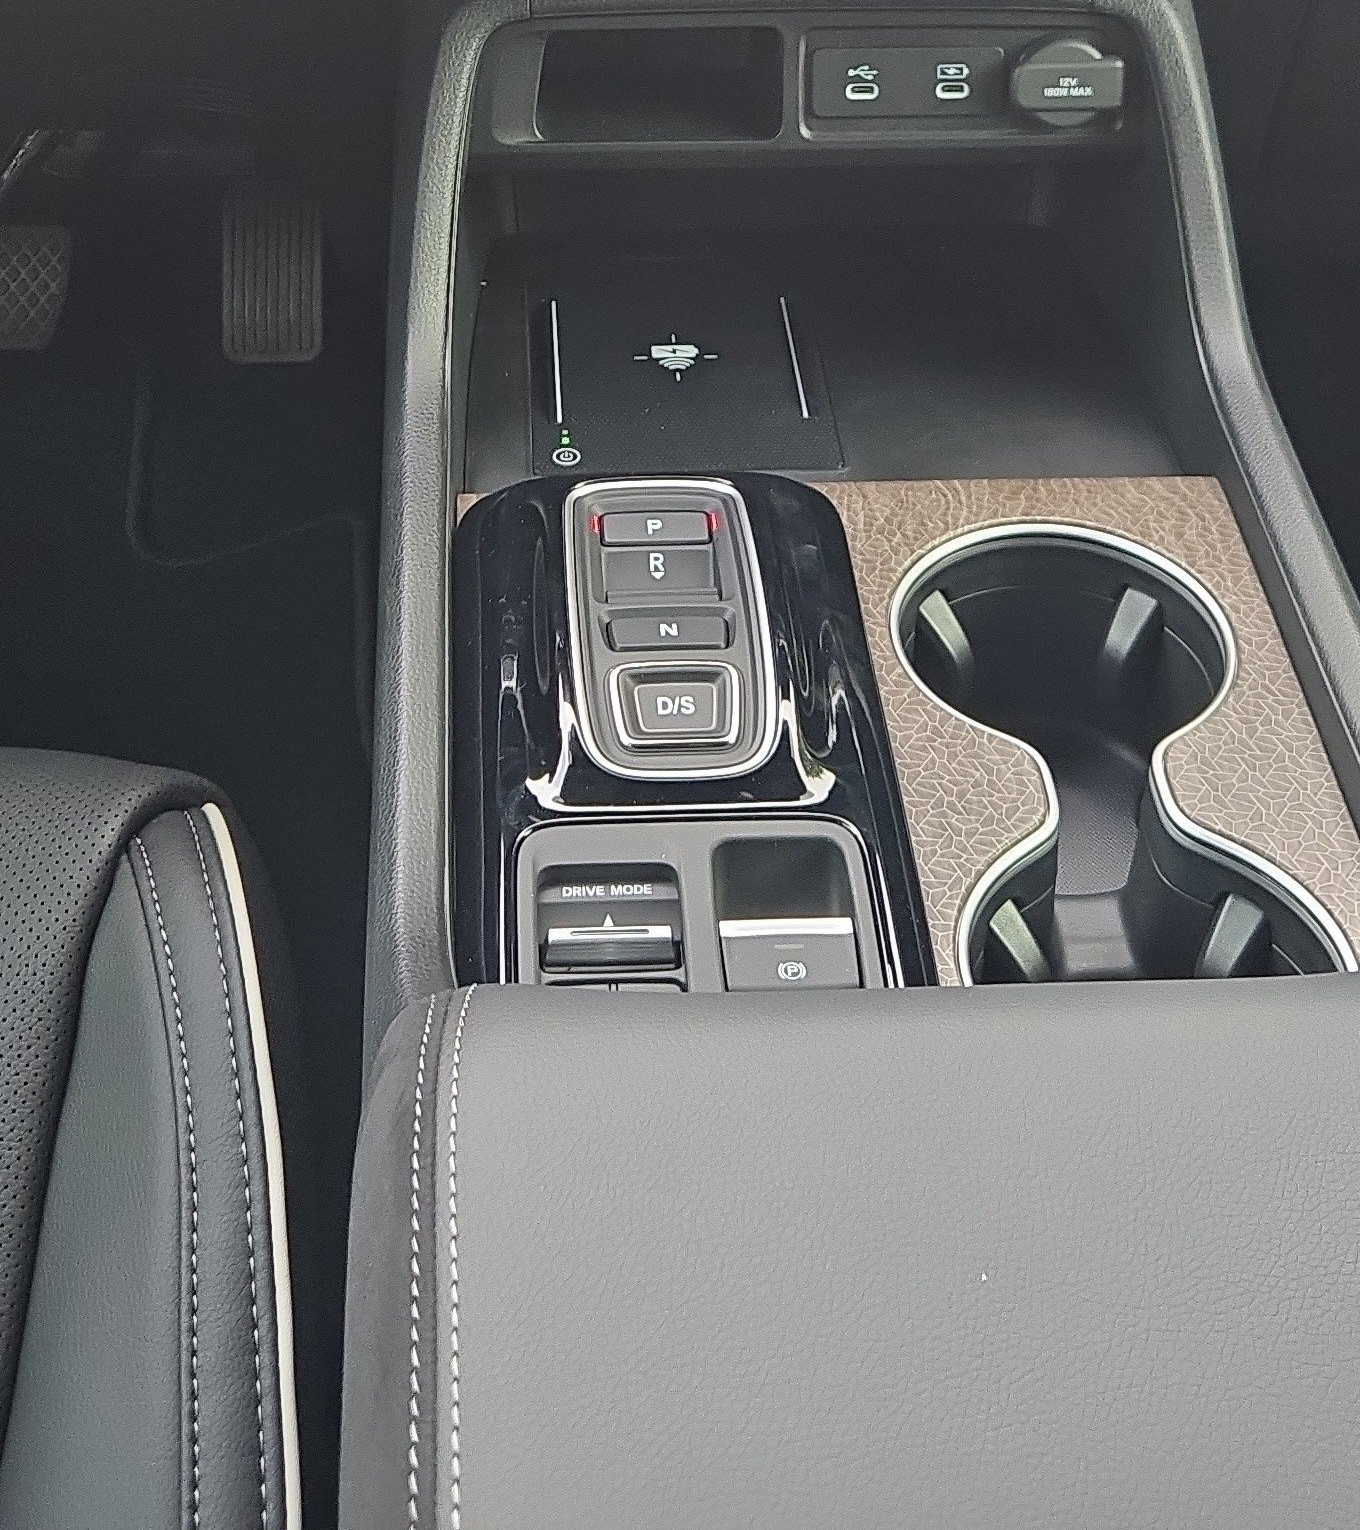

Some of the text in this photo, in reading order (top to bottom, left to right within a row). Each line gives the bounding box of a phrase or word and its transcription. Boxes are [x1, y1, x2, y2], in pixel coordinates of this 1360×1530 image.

[646, 518, 663, 536] P
[648, 553, 666, 573] R
[659, 622, 679, 638] N
[656, 694, 696, 717] D/S
[561, 883, 653, 899] DRIVE MODE
